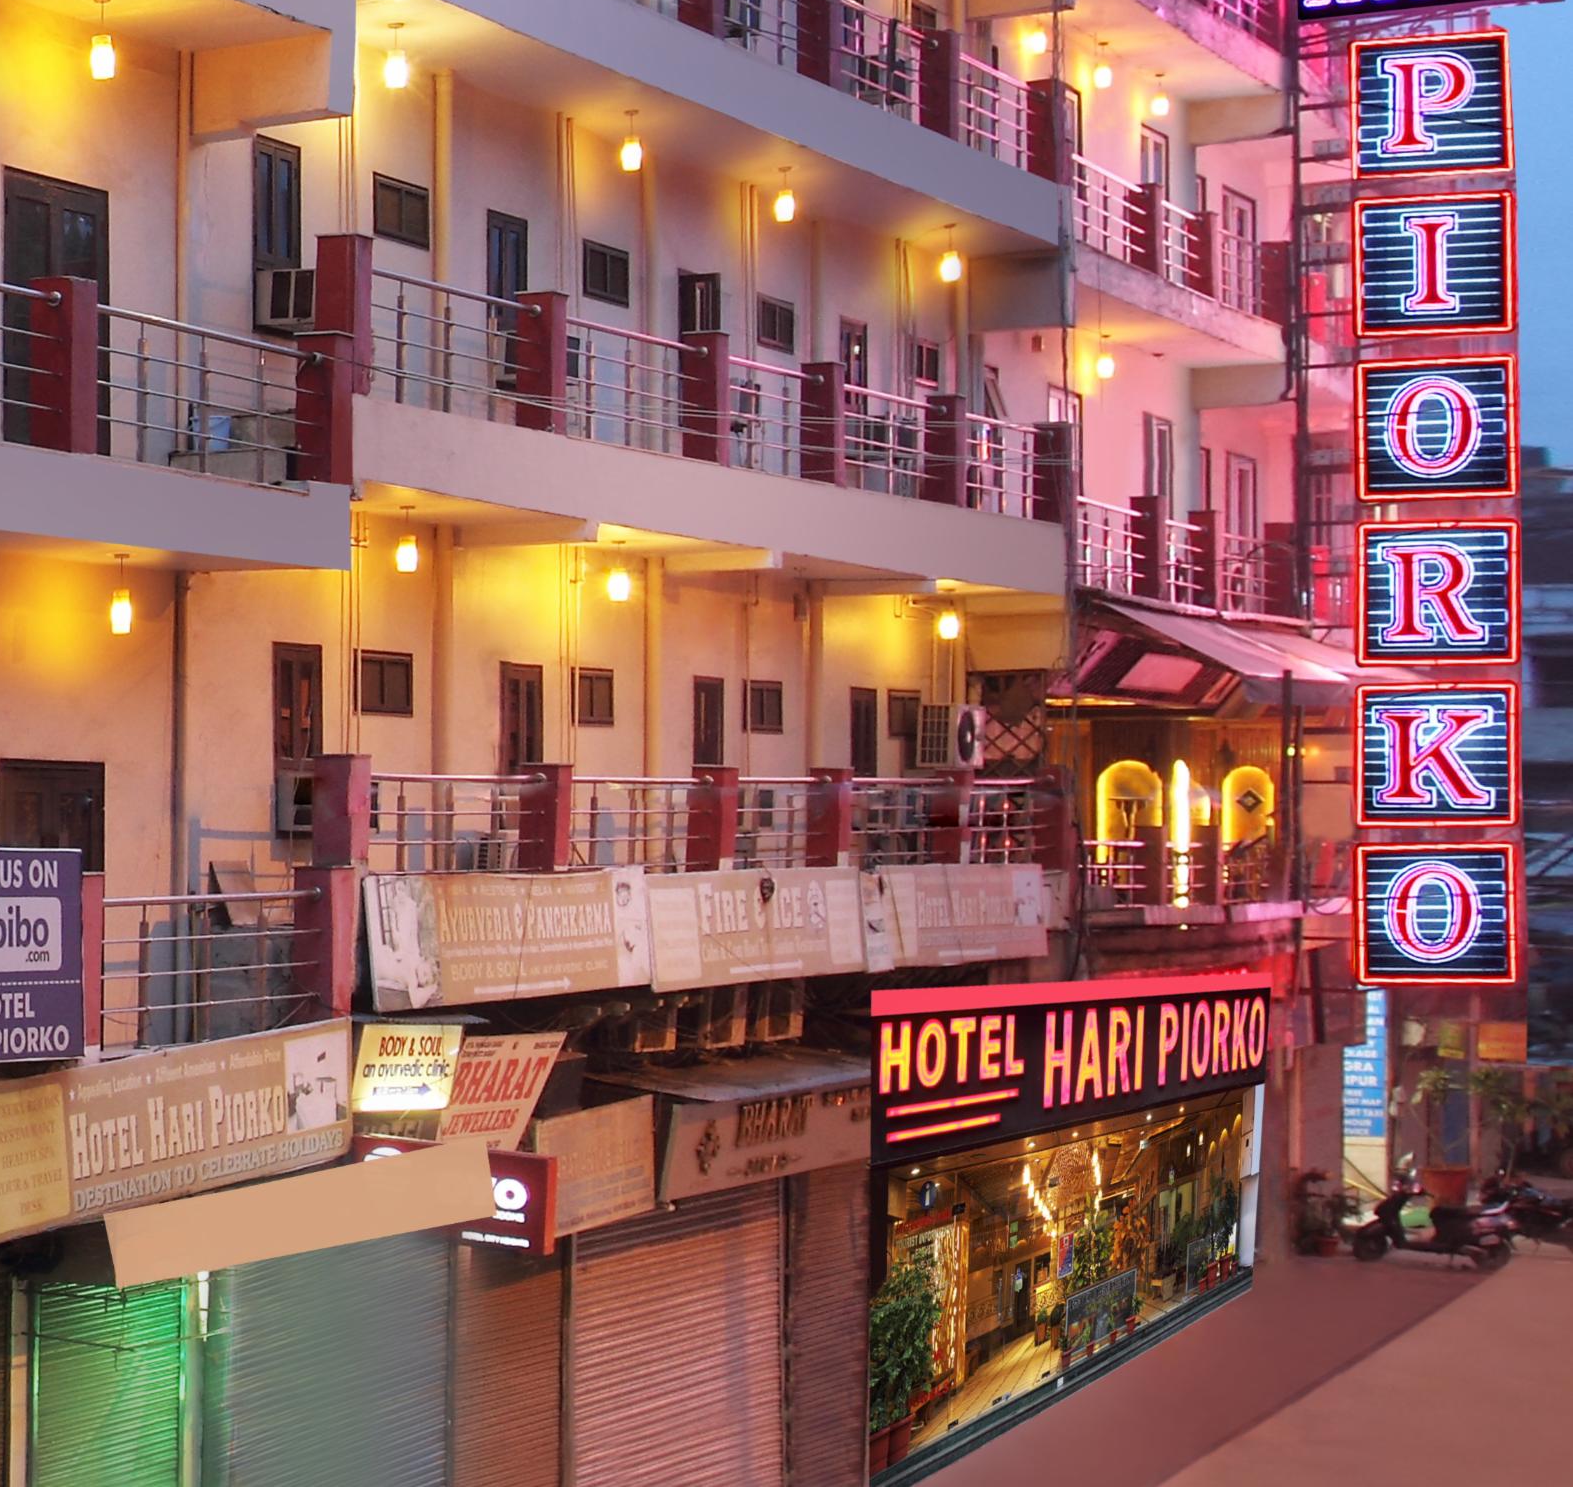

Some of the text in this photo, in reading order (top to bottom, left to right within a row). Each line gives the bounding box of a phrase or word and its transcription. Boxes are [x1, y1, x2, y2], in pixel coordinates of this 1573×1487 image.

[1375, 50, 1496, 965] PIORKO
[0, 859, 24, 888] US
[28, 860, 59, 888] ON
[439, 900, 512, 943] AYURVEDA
[526, 900, 612, 940] PANCHKARMA
[698, 883, 750, 936] FIRE
[917, 890, 951, 928] HOTEL
[25, 949, 51, 963] .com
[451, 959, 482, 982] BODY
[378, 1035, 406, 1057] BODY
[408, 1036, 415, 1055] &
[418, 1035, 444, 1057] SOUL
[878, 994, 1267, 1110] HOTEL HARI PIORKO
[363, 1058, 450, 1081] an ayurvedic clinic
[450, 1056, 549, 1105] BHARAT
[69, 1084, 285, 1180] HOTEL HARI PIORKO
[442, 1108, 519, 1136] JEWELLERS
[73, 1130, 344, 1212] DESTINATION TO CELEBRATE HOLIDAYS
